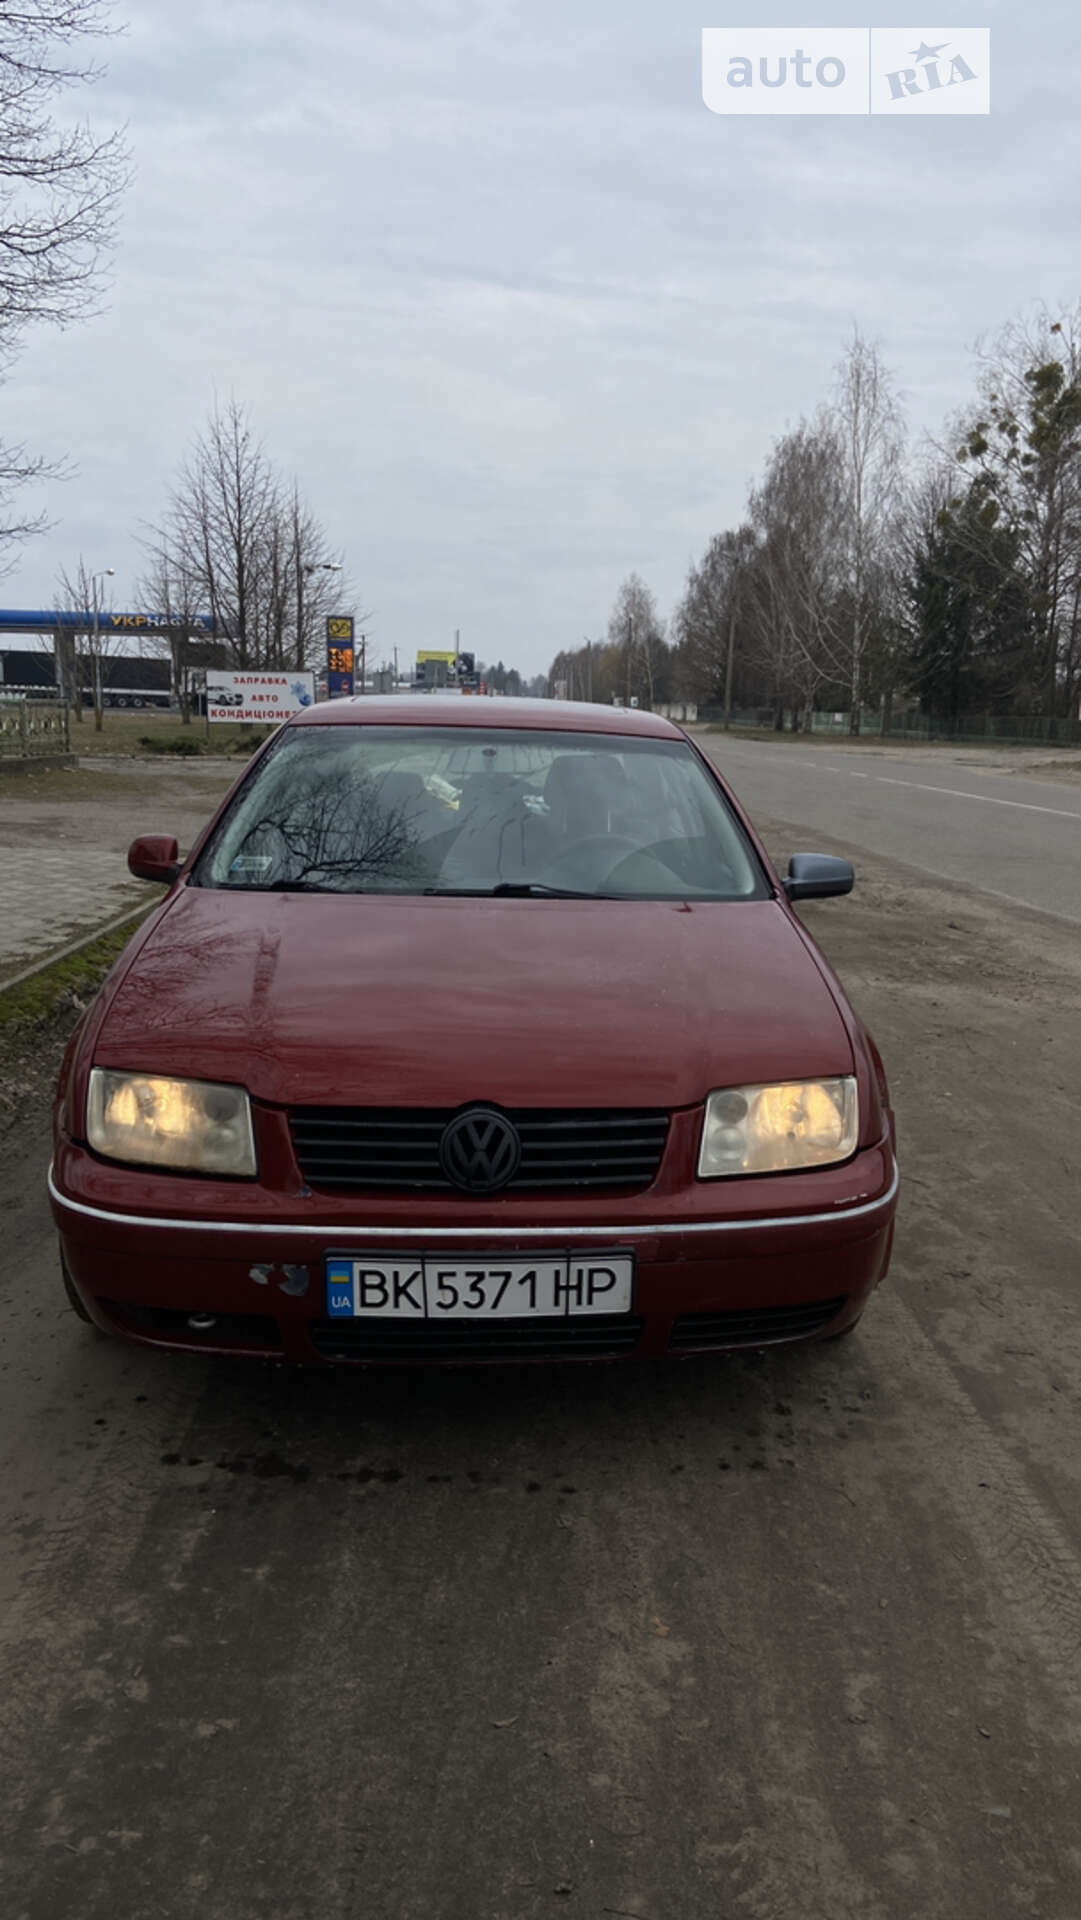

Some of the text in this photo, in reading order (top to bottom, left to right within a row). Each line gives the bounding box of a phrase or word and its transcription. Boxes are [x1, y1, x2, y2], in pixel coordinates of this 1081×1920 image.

[233, 676, 288, 686] ЗАПРАВКА
[251, 694, 279, 703] АВТО
[211, 709, 297, 720] КОНДИЦІОНЕ
[359, 1268, 617, 1310] BK 5371 HP
[331, 1295, 352, 1309] UA
